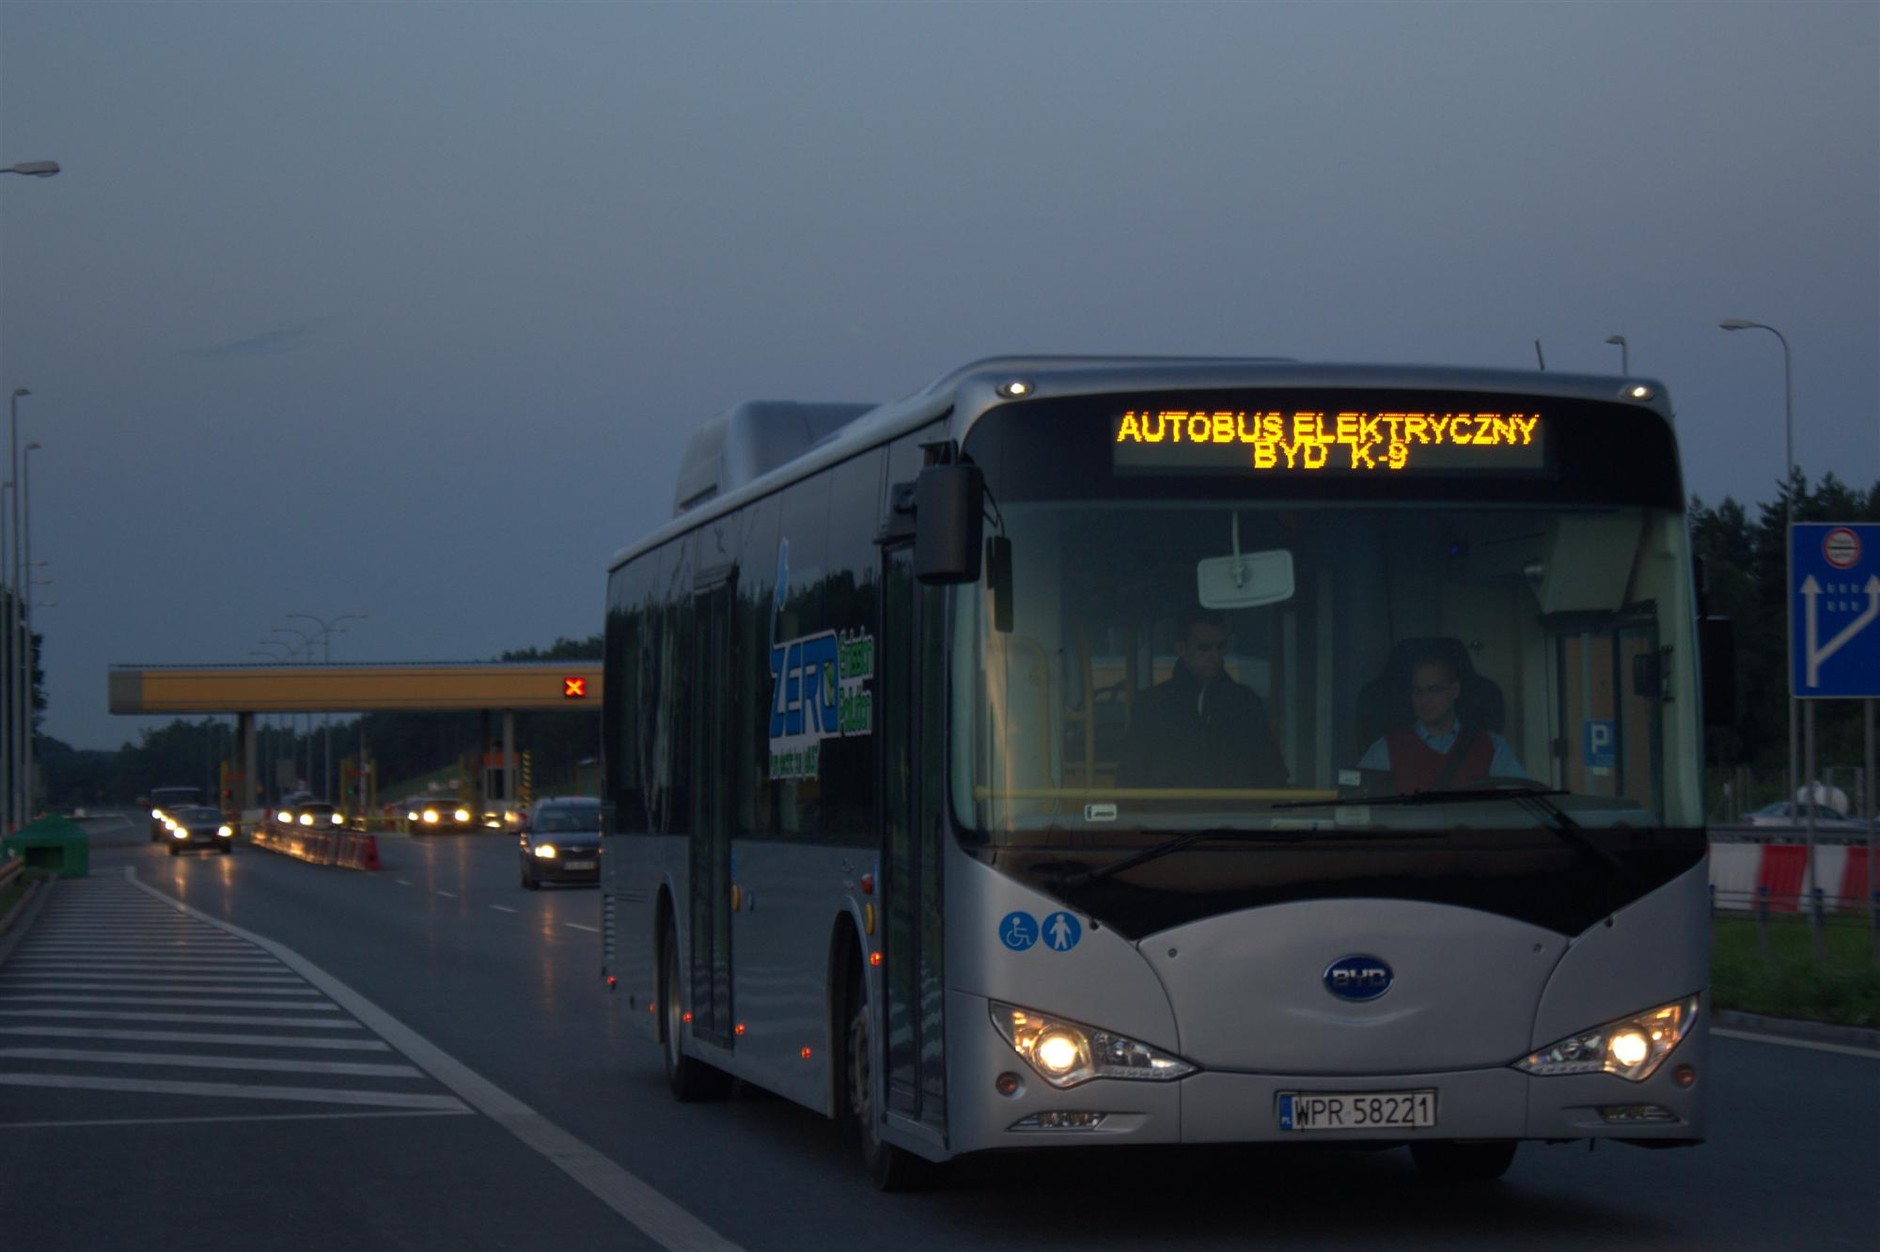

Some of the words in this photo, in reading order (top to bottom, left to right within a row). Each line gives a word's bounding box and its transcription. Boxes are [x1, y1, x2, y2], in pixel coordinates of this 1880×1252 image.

[1116, 411, 1284, 443] AUTOBUS
[1293, 412, 1540, 444] ELEKTRYCZNY
[1254, 439, 1328, 469] BYD
[1351, 439, 1408, 469] K-9
[769, 632, 839, 739] ZERO
[1332, 968, 1388, 987] BYD
[1294, 1099, 1344, 1125] WPR
[1354, 1096, 1429, 1123] 58221
